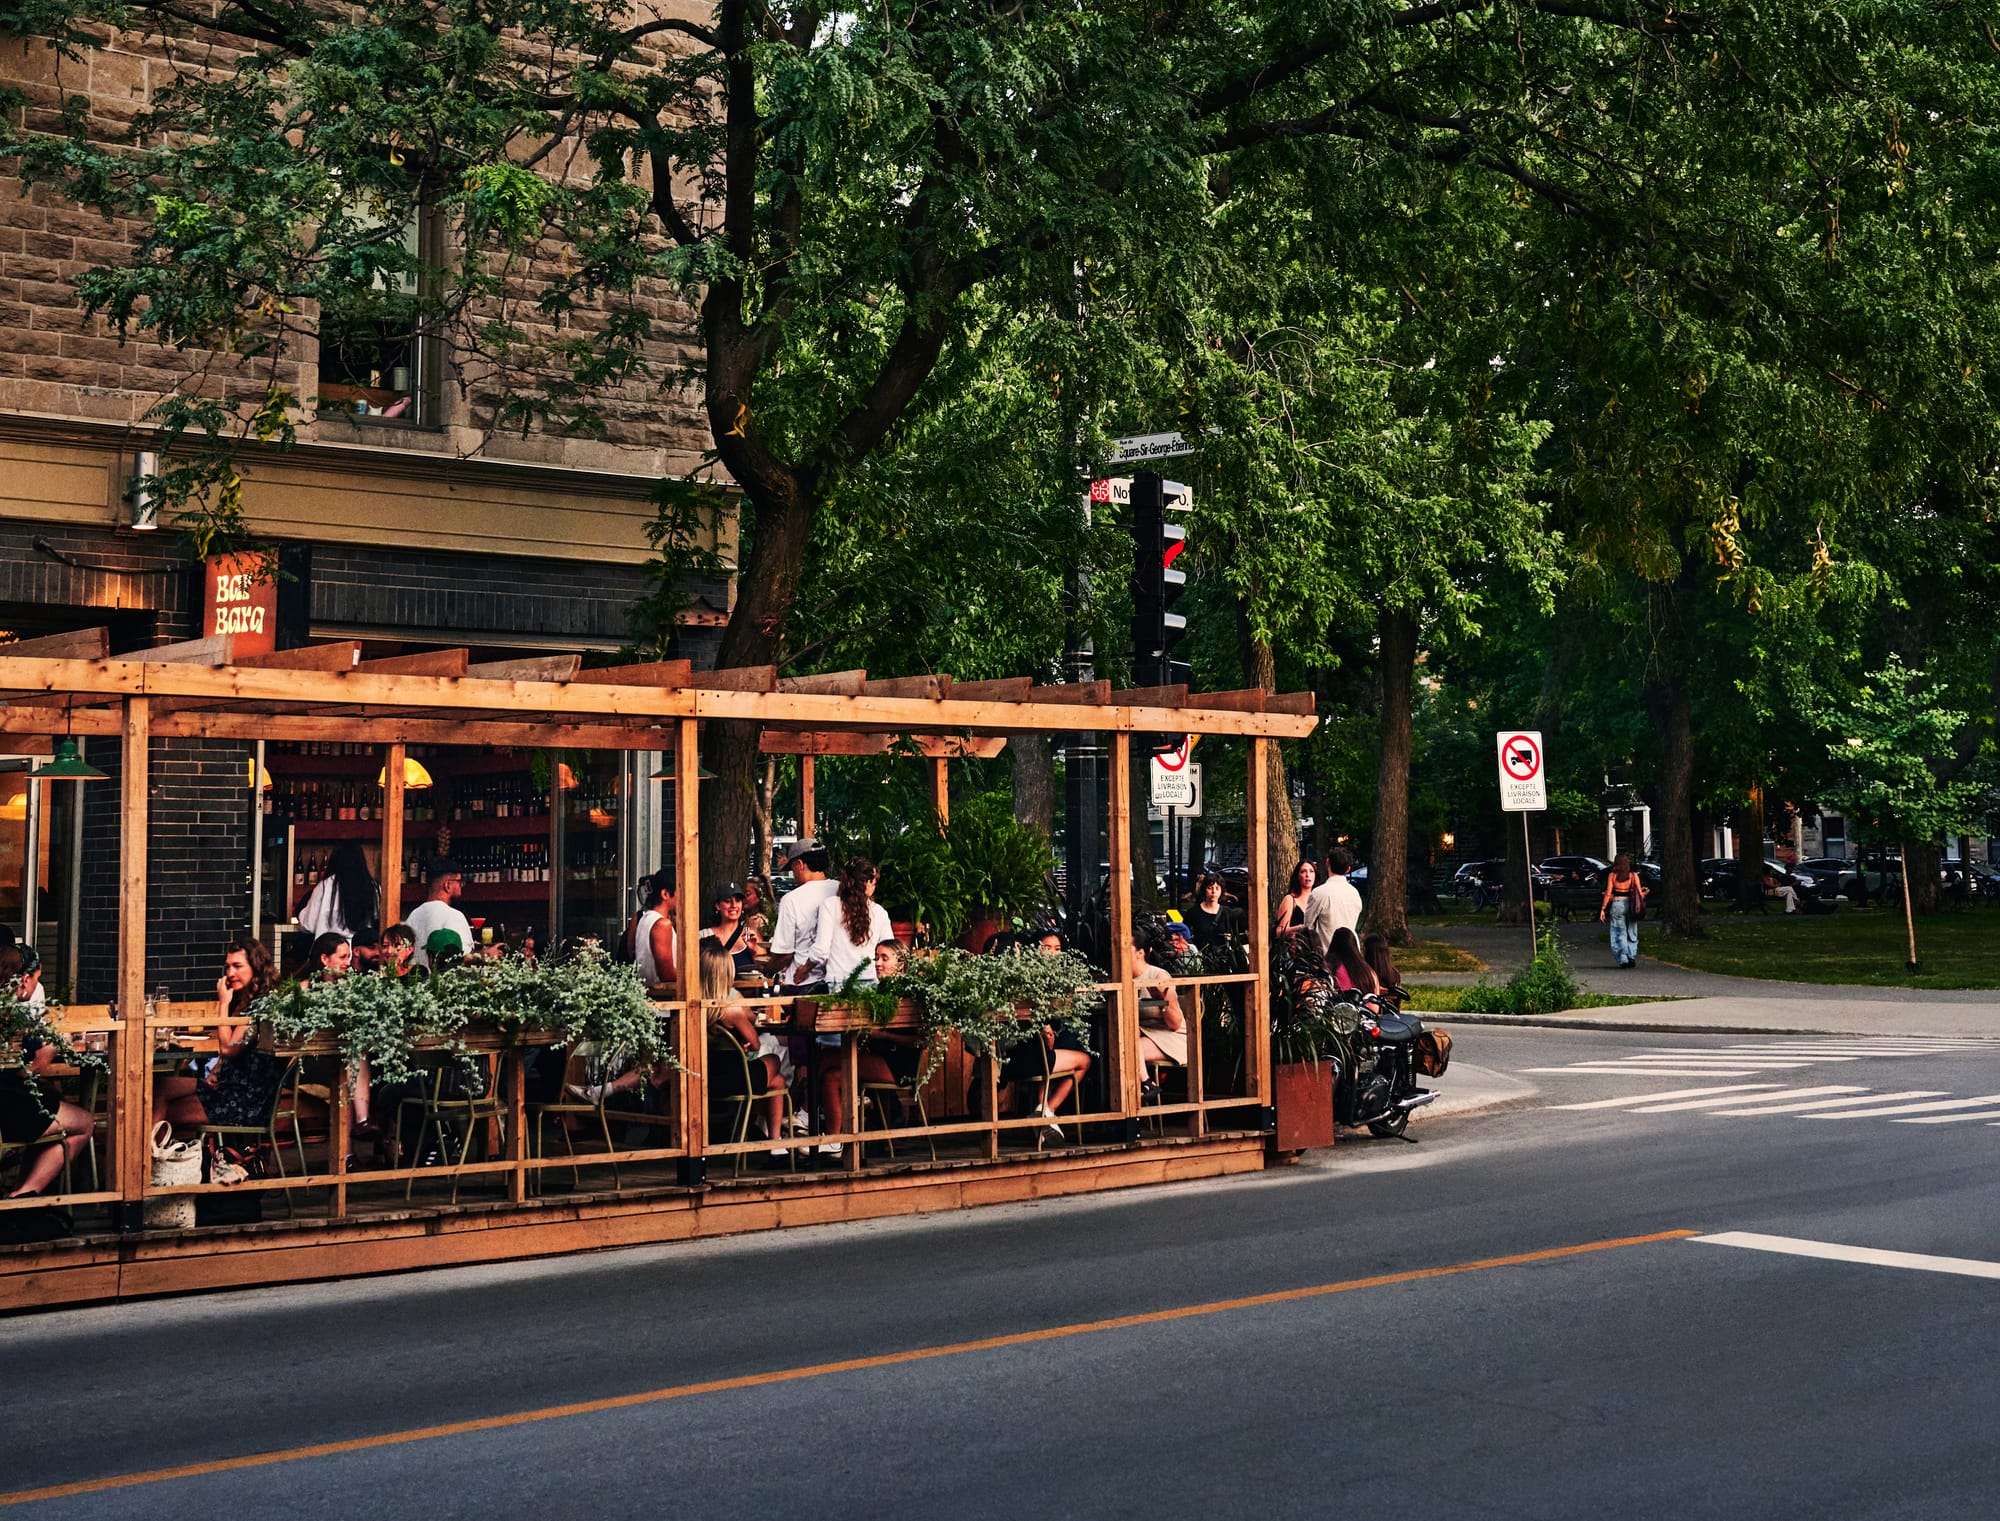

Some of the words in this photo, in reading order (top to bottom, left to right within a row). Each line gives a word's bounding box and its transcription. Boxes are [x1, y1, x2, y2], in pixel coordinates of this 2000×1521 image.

[215, 606, 265, 635] Bara
[1157, 782, 1187, 791] LIVRAISON
[1162, 791, 1184, 799] LOCALE
[1507, 790, 1541, 798] LIVRAISON
